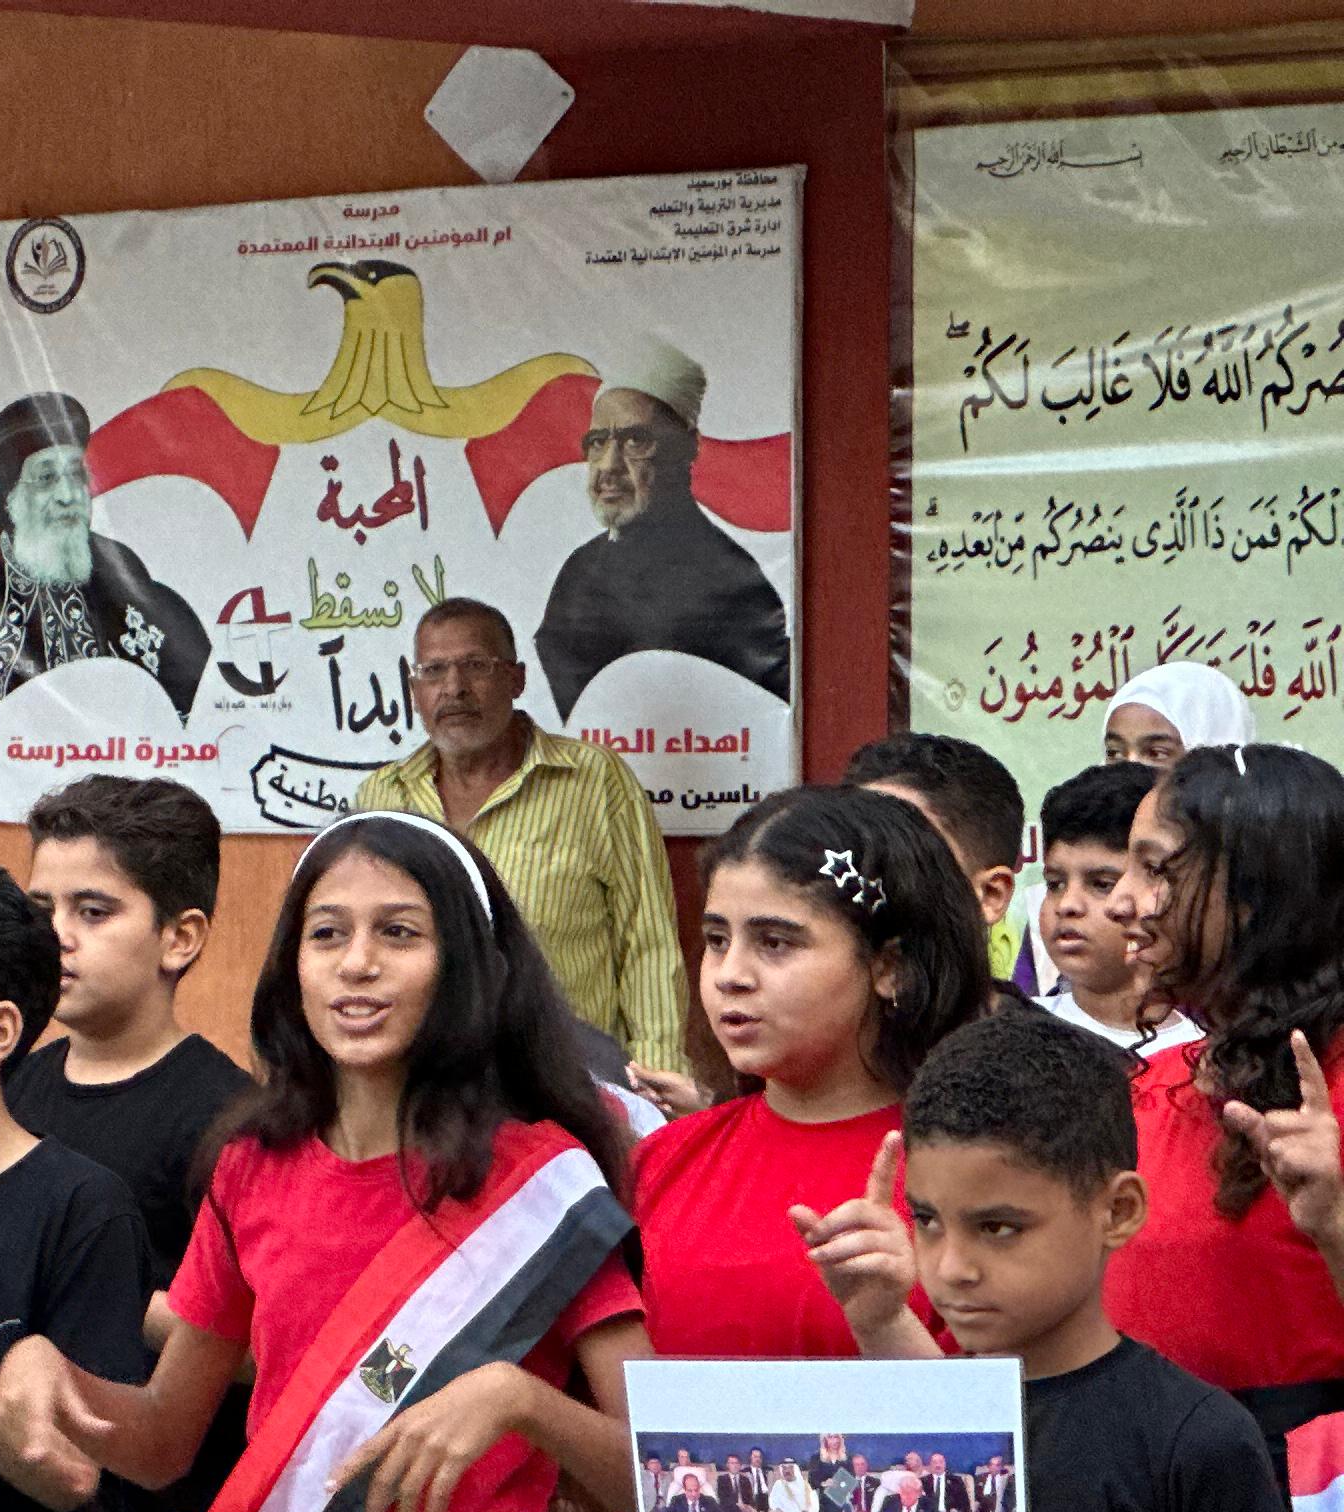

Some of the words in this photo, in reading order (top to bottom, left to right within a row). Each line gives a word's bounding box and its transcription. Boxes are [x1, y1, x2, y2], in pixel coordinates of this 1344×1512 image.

[343, 202, 401, 221] مدرسة
[237, 235, 319, 257] المعتمدة
[492, 225, 512, 247] ام
[315, 438, 429, 552] المحبة
[299, 557, 403, 631] تسقط
[6, 735, 127, 769] المدرسة
[135, 735, 218, 769] مديرة
[664, 726, 750, 762] إهداء
